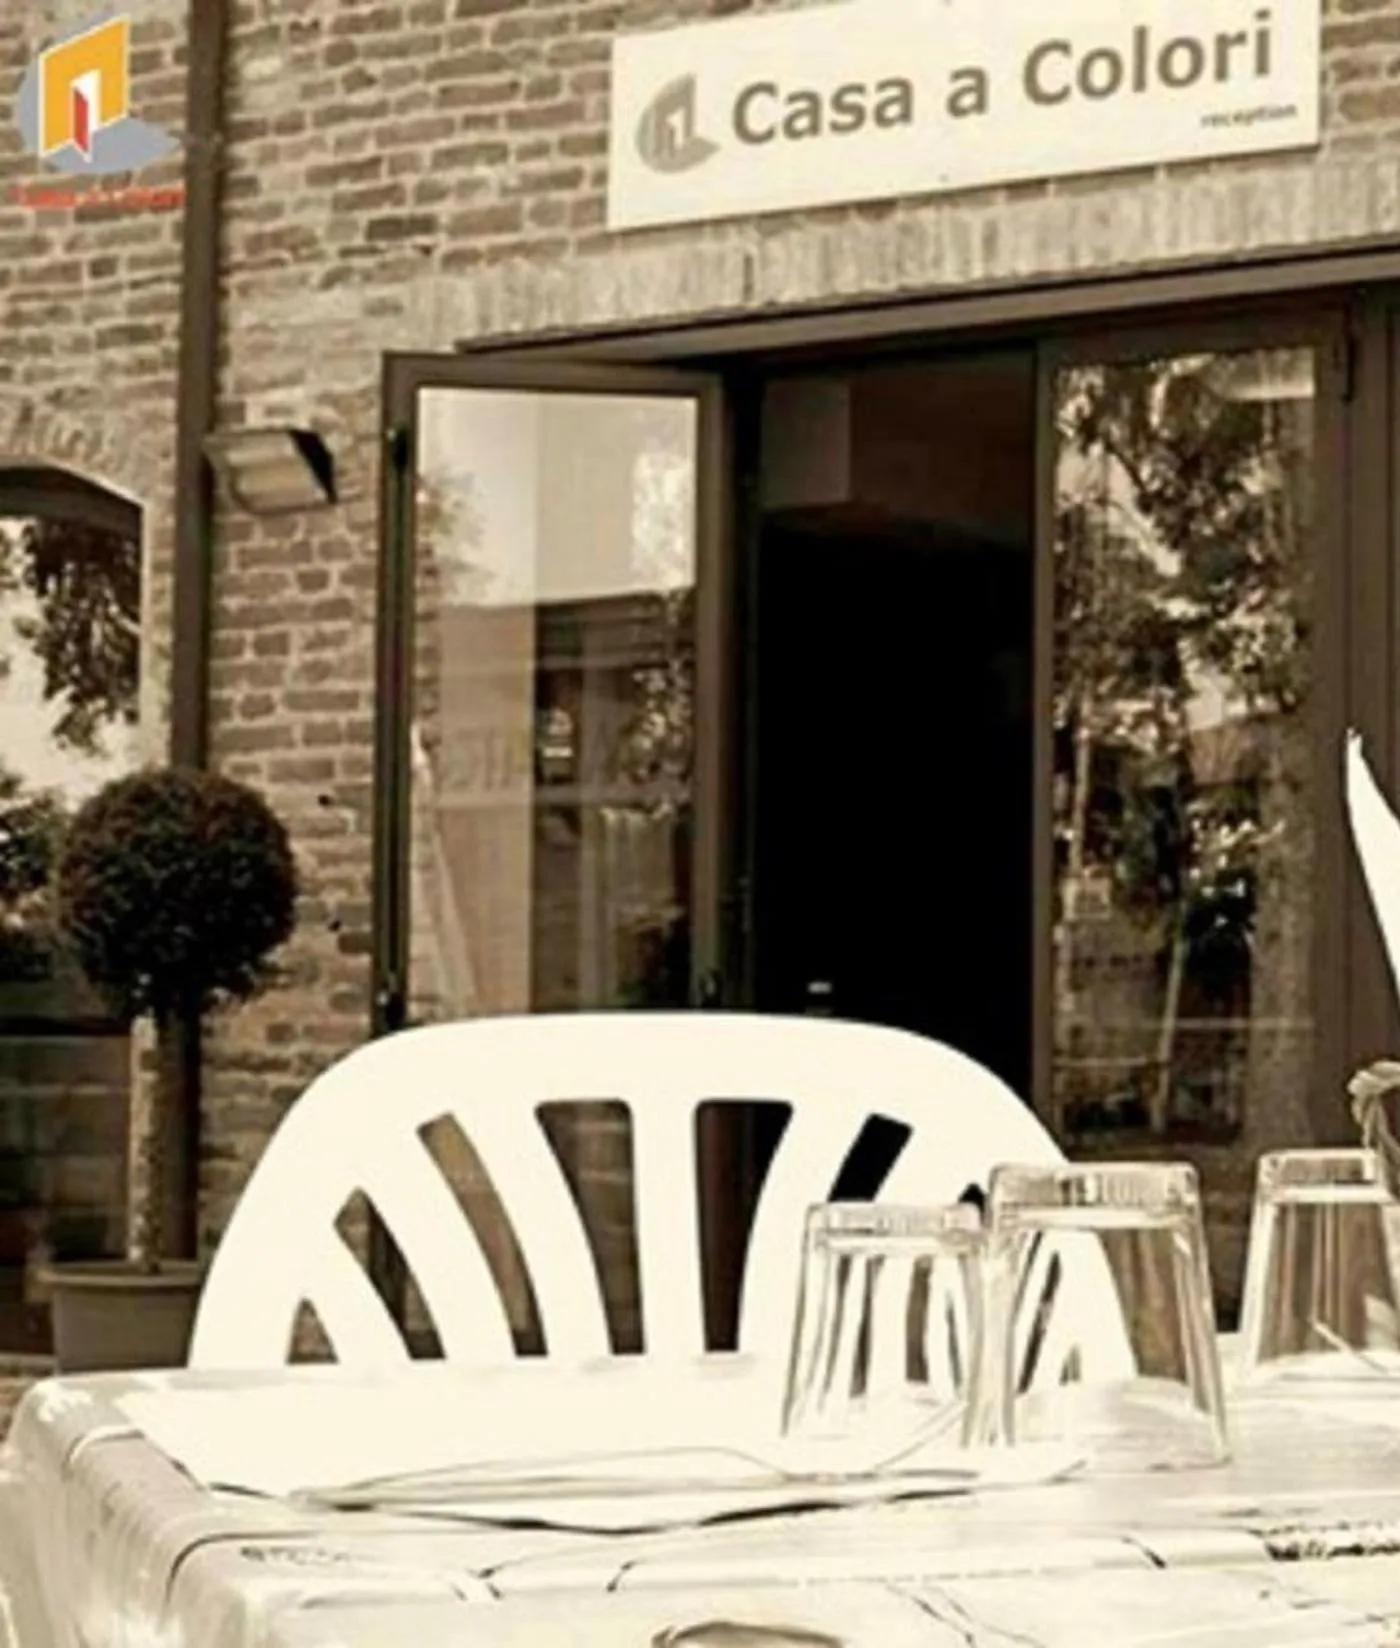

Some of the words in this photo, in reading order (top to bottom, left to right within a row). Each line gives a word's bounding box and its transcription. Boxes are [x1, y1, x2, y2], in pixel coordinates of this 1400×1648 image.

[731, 76, 915, 147] Casa
[944, 65, 990, 119] a
[1021, 8, 1273, 107] Colori
